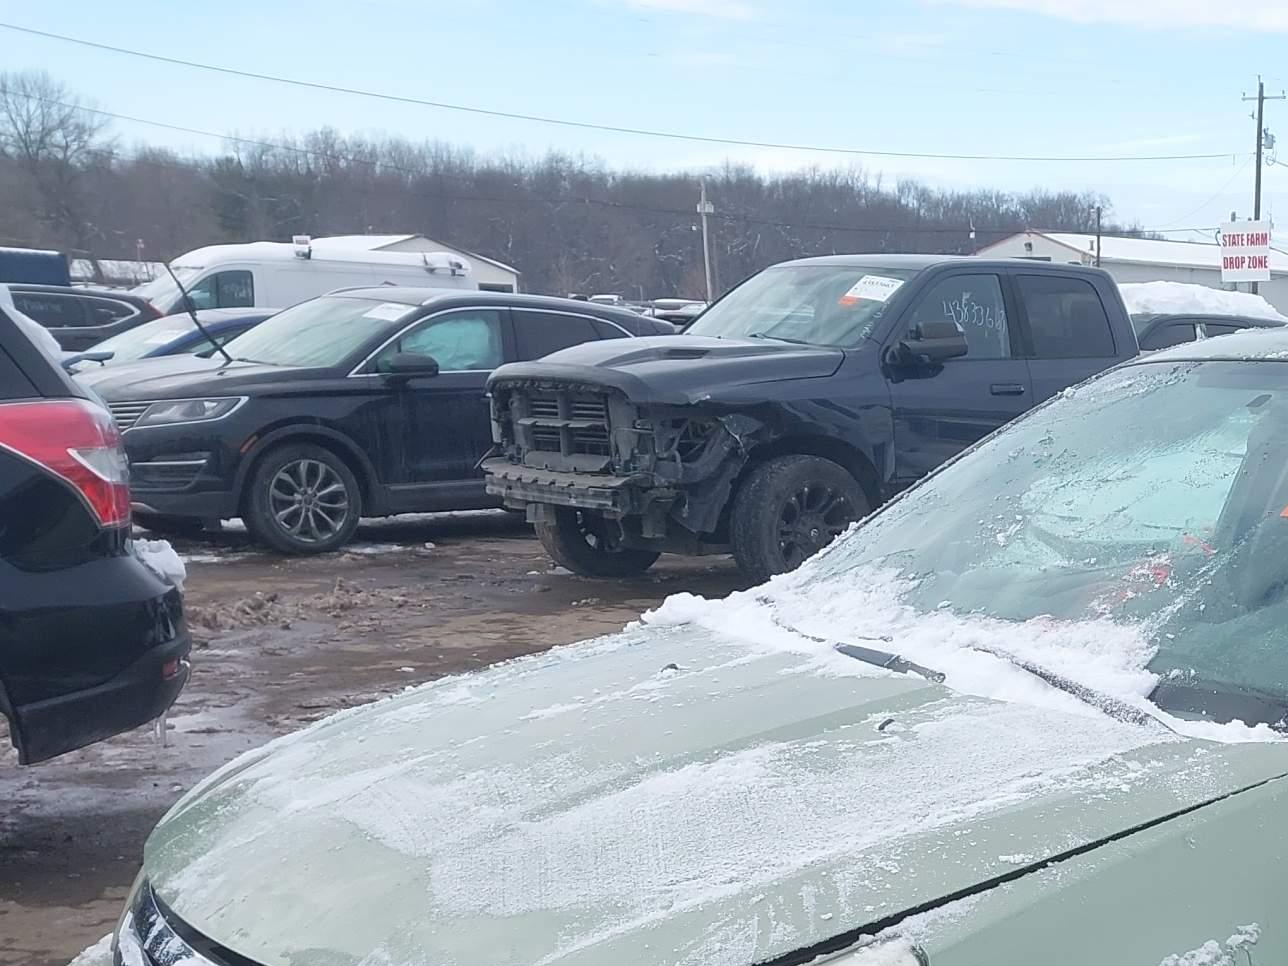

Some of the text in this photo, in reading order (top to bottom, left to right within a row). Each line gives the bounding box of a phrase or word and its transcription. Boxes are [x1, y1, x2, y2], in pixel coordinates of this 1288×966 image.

[1222, 232, 1268, 247] STATE FARM
[1223, 255, 1268, 269] DROP ZONE
